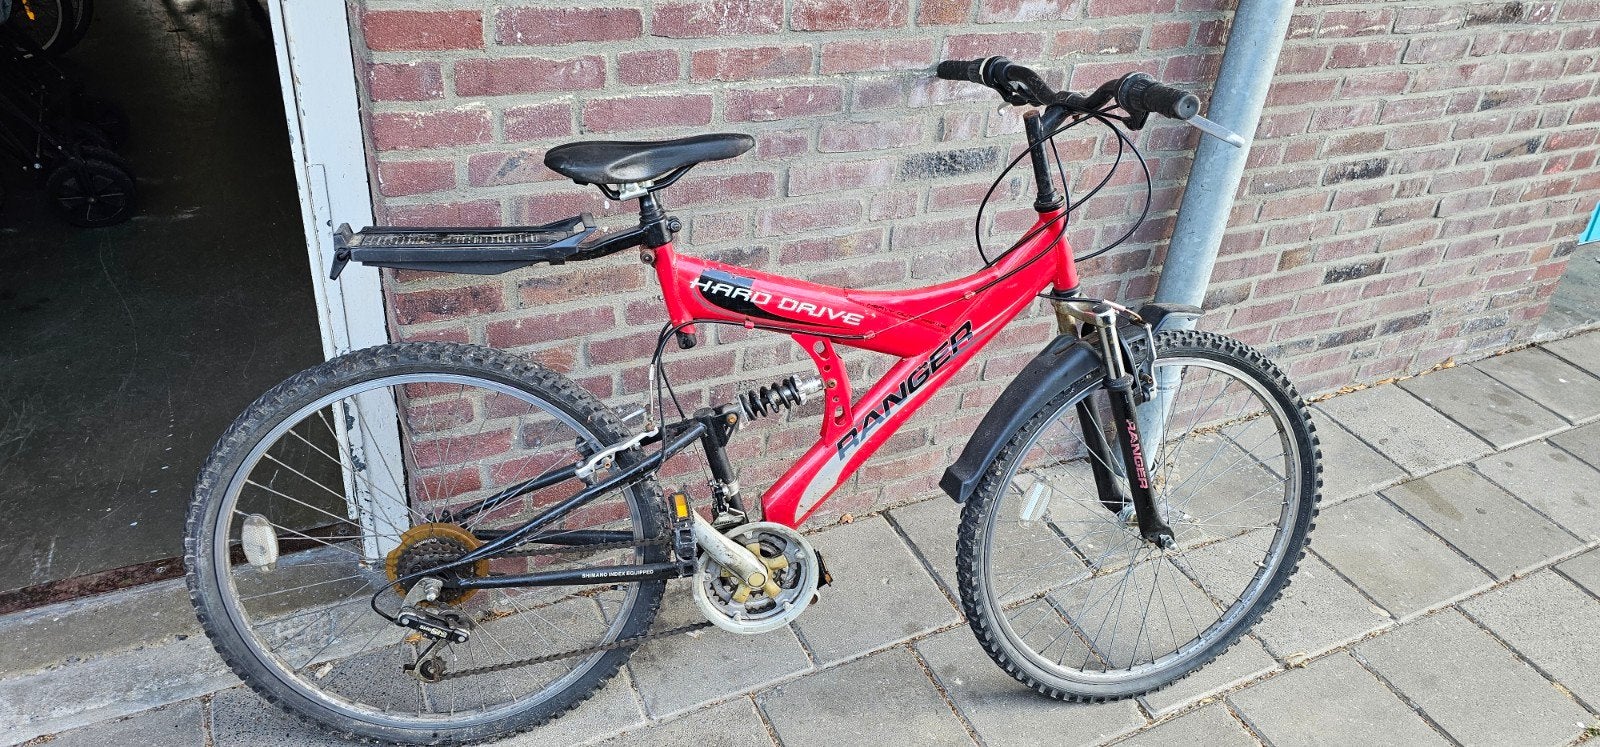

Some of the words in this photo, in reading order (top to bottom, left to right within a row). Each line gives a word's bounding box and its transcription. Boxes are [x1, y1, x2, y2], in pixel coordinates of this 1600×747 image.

[690, 277, 772, 305] HARD
[778, 297, 864, 326] DRIVE
[836, 320, 974, 461] RANGER
[1126, 419, 1149, 489] RANGER
